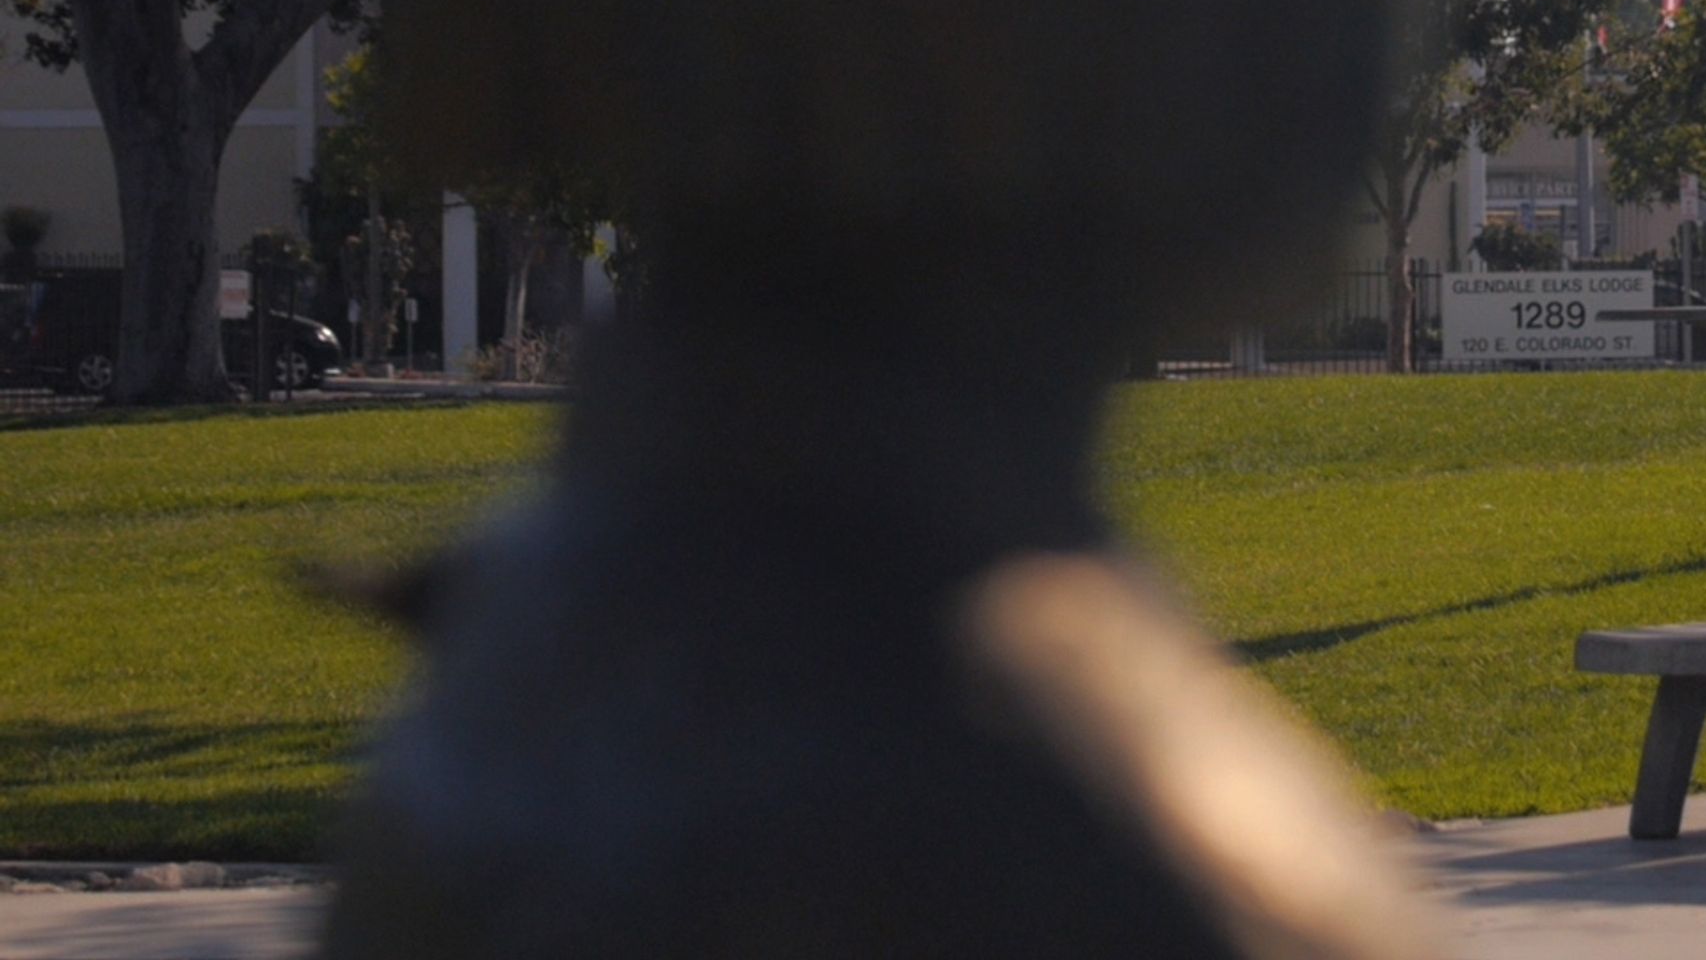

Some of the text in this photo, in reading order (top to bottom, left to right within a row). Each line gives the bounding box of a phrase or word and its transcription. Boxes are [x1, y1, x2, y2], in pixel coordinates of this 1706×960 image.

[1453, 277, 1643, 294] GLENDALE ELKS LODGE
[1510, 300, 1586, 330] 1289
[1462, 338, 1488, 352] 120
[1515, 337, 1606, 352] COLORADO
